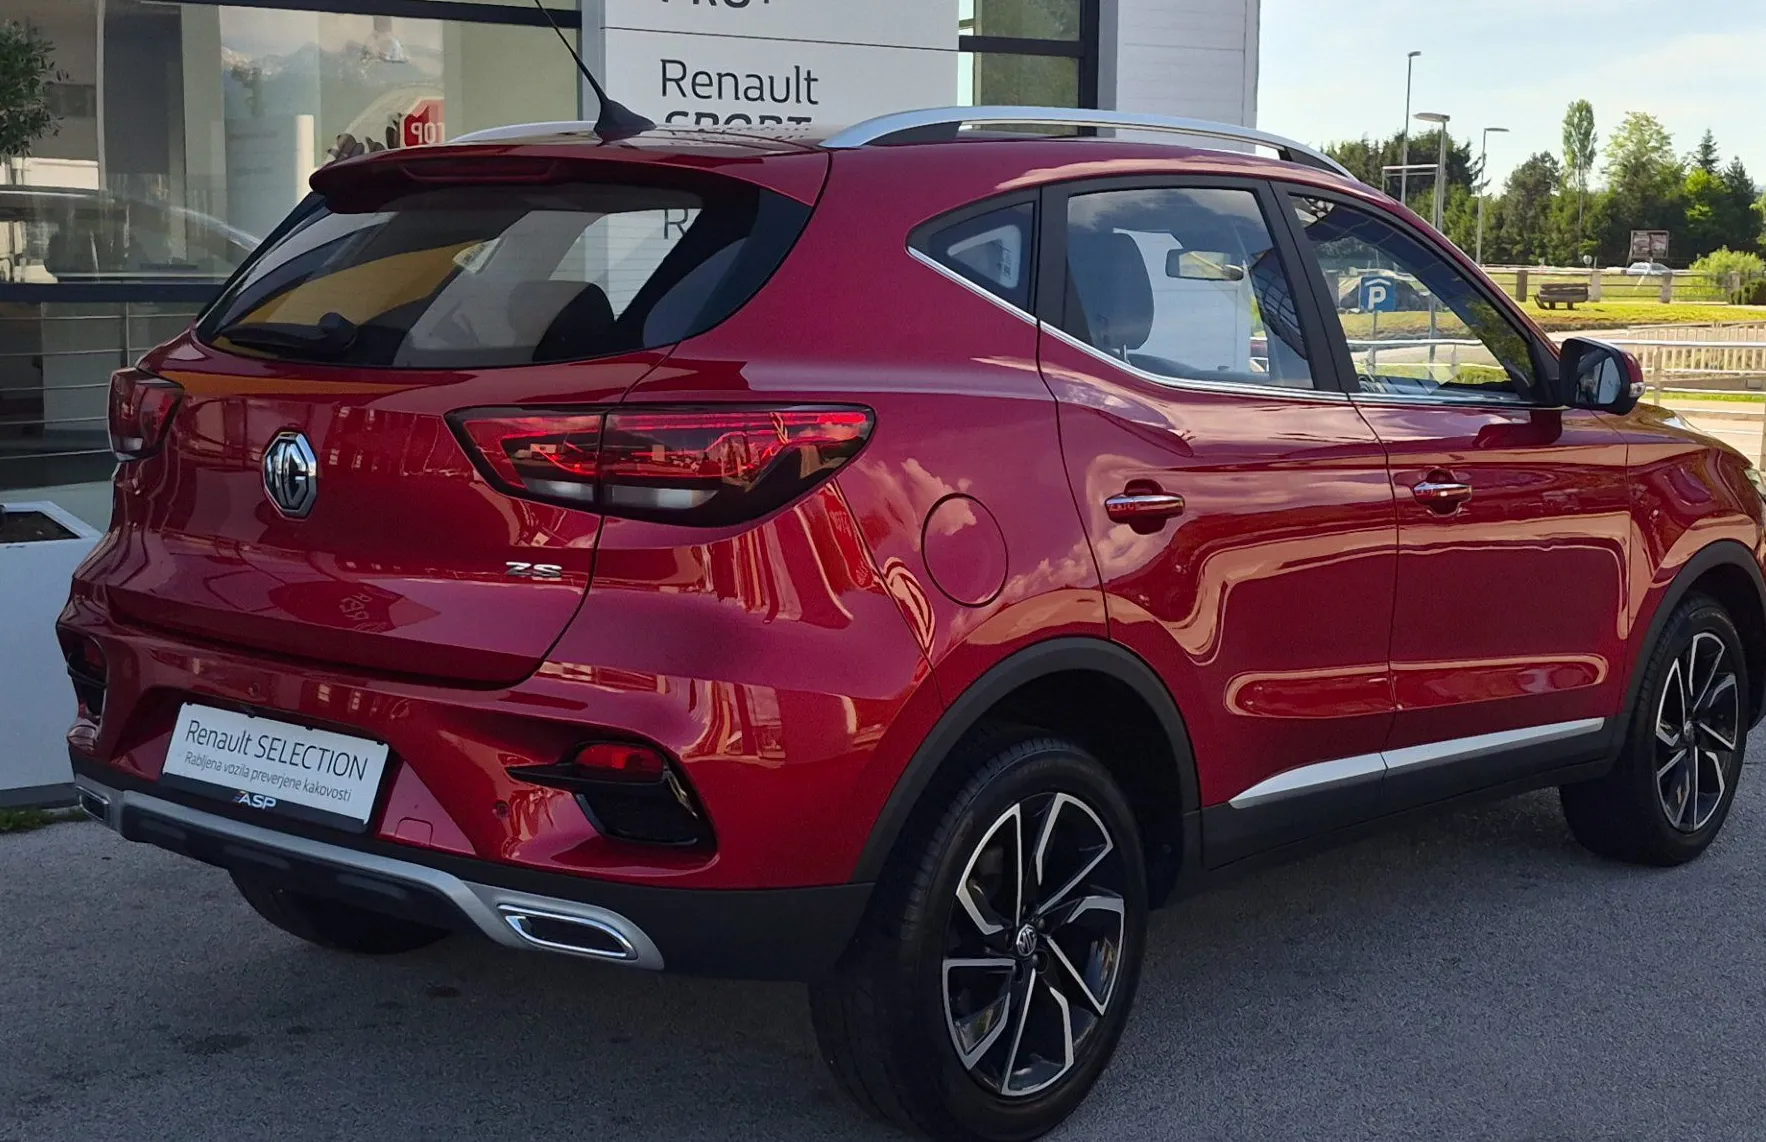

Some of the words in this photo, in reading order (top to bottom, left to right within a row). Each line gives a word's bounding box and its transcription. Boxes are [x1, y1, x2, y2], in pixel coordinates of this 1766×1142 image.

[660, 58, 819, 105] Renault
[1367, 286, 1387, 310] P
[265, 440, 309, 509] MG
[504, 561, 562, 579] ZS
[185, 719, 252, 755] Renault
[254, 734, 369, 782] SELECTION
[184, 750, 223, 772] Rabljena
[223, 761, 250, 778] vozila
[250, 768, 301, 790] preverjene
[302, 777, 352, 802] kakovosti
[237, 791, 277, 810] ASP
